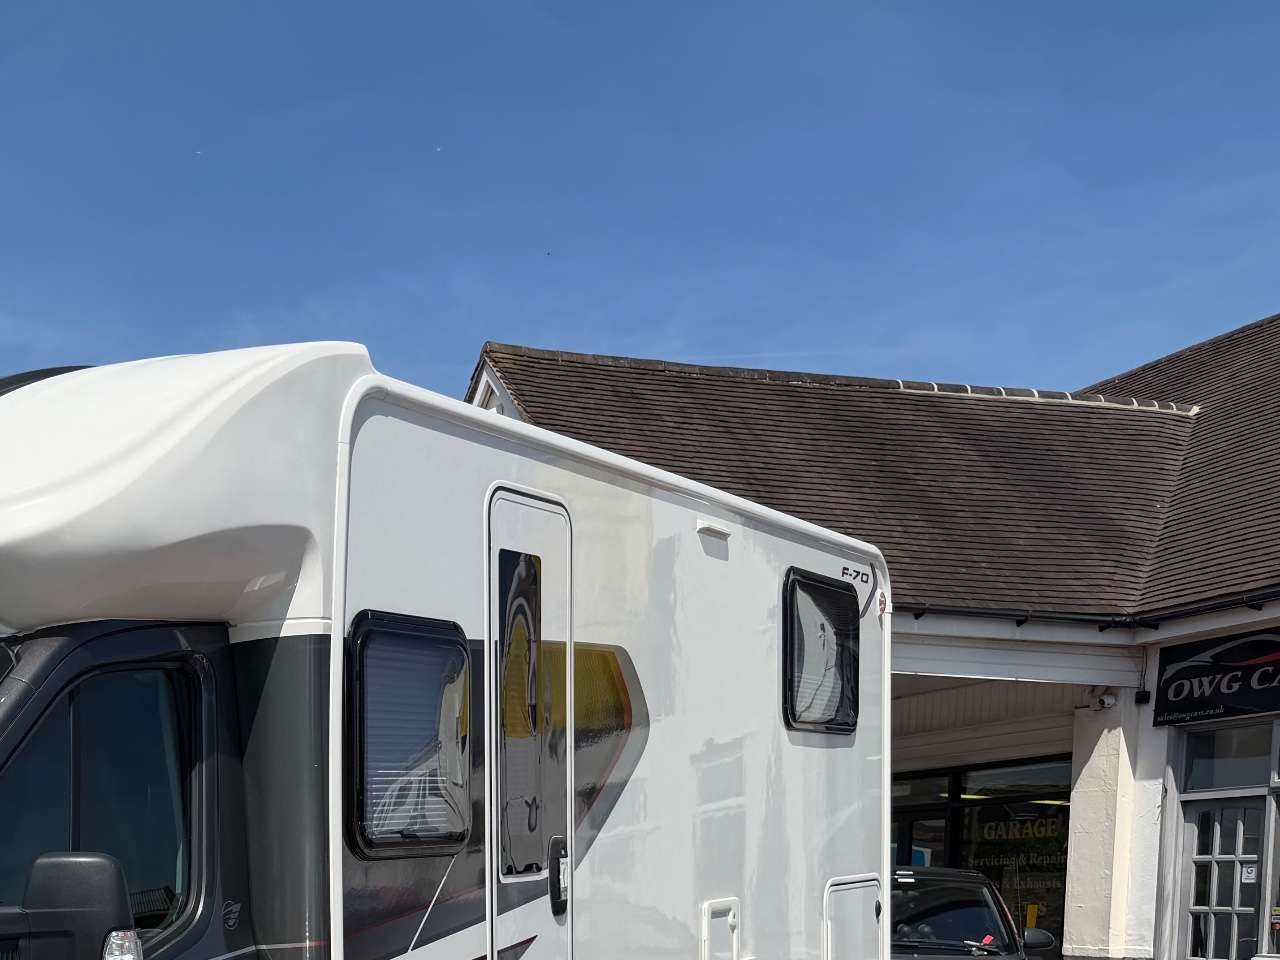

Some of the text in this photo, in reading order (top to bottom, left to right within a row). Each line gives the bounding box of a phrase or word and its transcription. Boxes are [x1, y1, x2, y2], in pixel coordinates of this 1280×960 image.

[841, 566, 869, 584] F-70
[1167, 671, 1242, 701] OWG
[984, 818, 1057, 840] GARAGE
[968, 854, 1017, 867] Servicing
